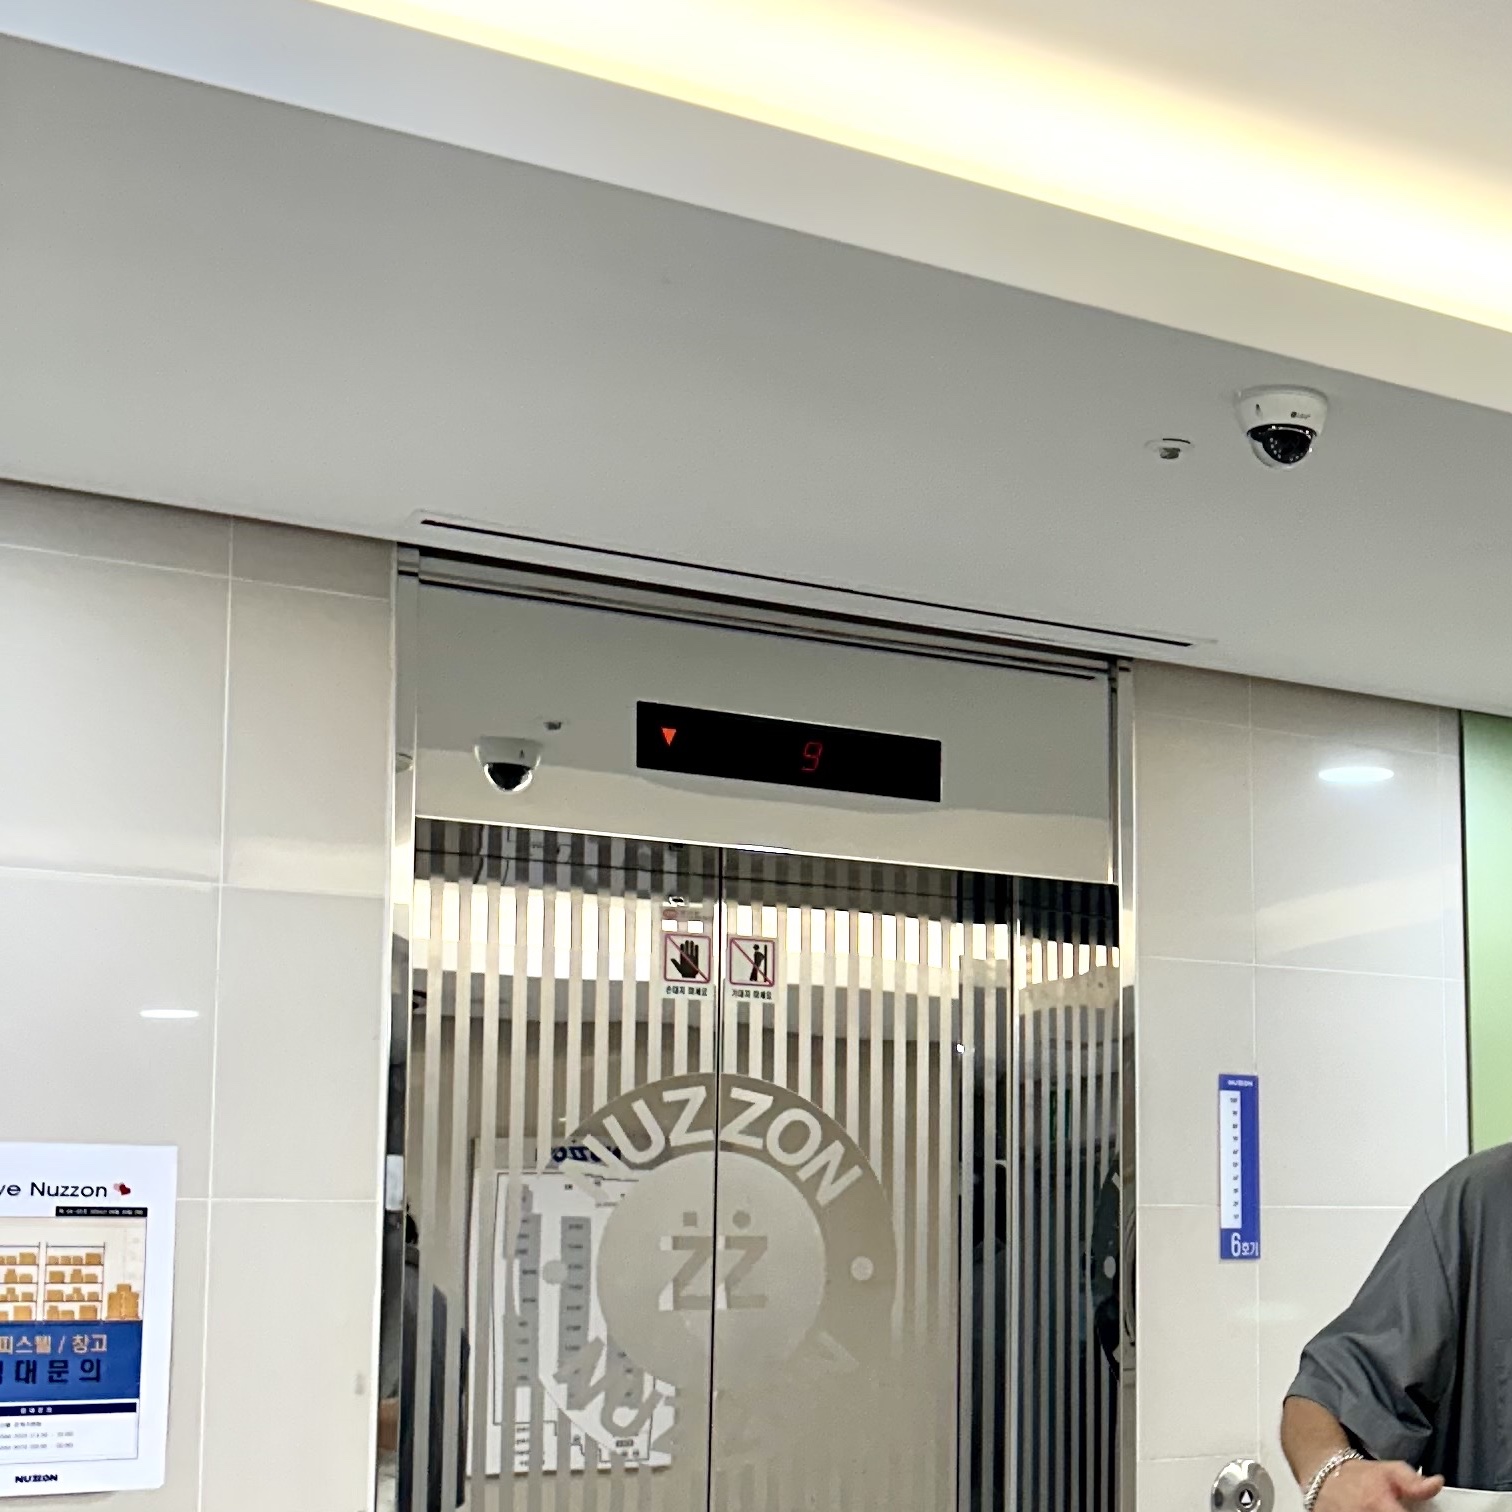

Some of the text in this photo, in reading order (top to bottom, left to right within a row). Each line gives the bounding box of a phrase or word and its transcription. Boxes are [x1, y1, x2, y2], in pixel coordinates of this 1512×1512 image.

[801, 742, 823, 772] 9
[558, 1085, 862, 1207] NUZZON
[30, 1181, 108, 1197] Nuzzon
[72, 1334, 108, 1354] 창고
